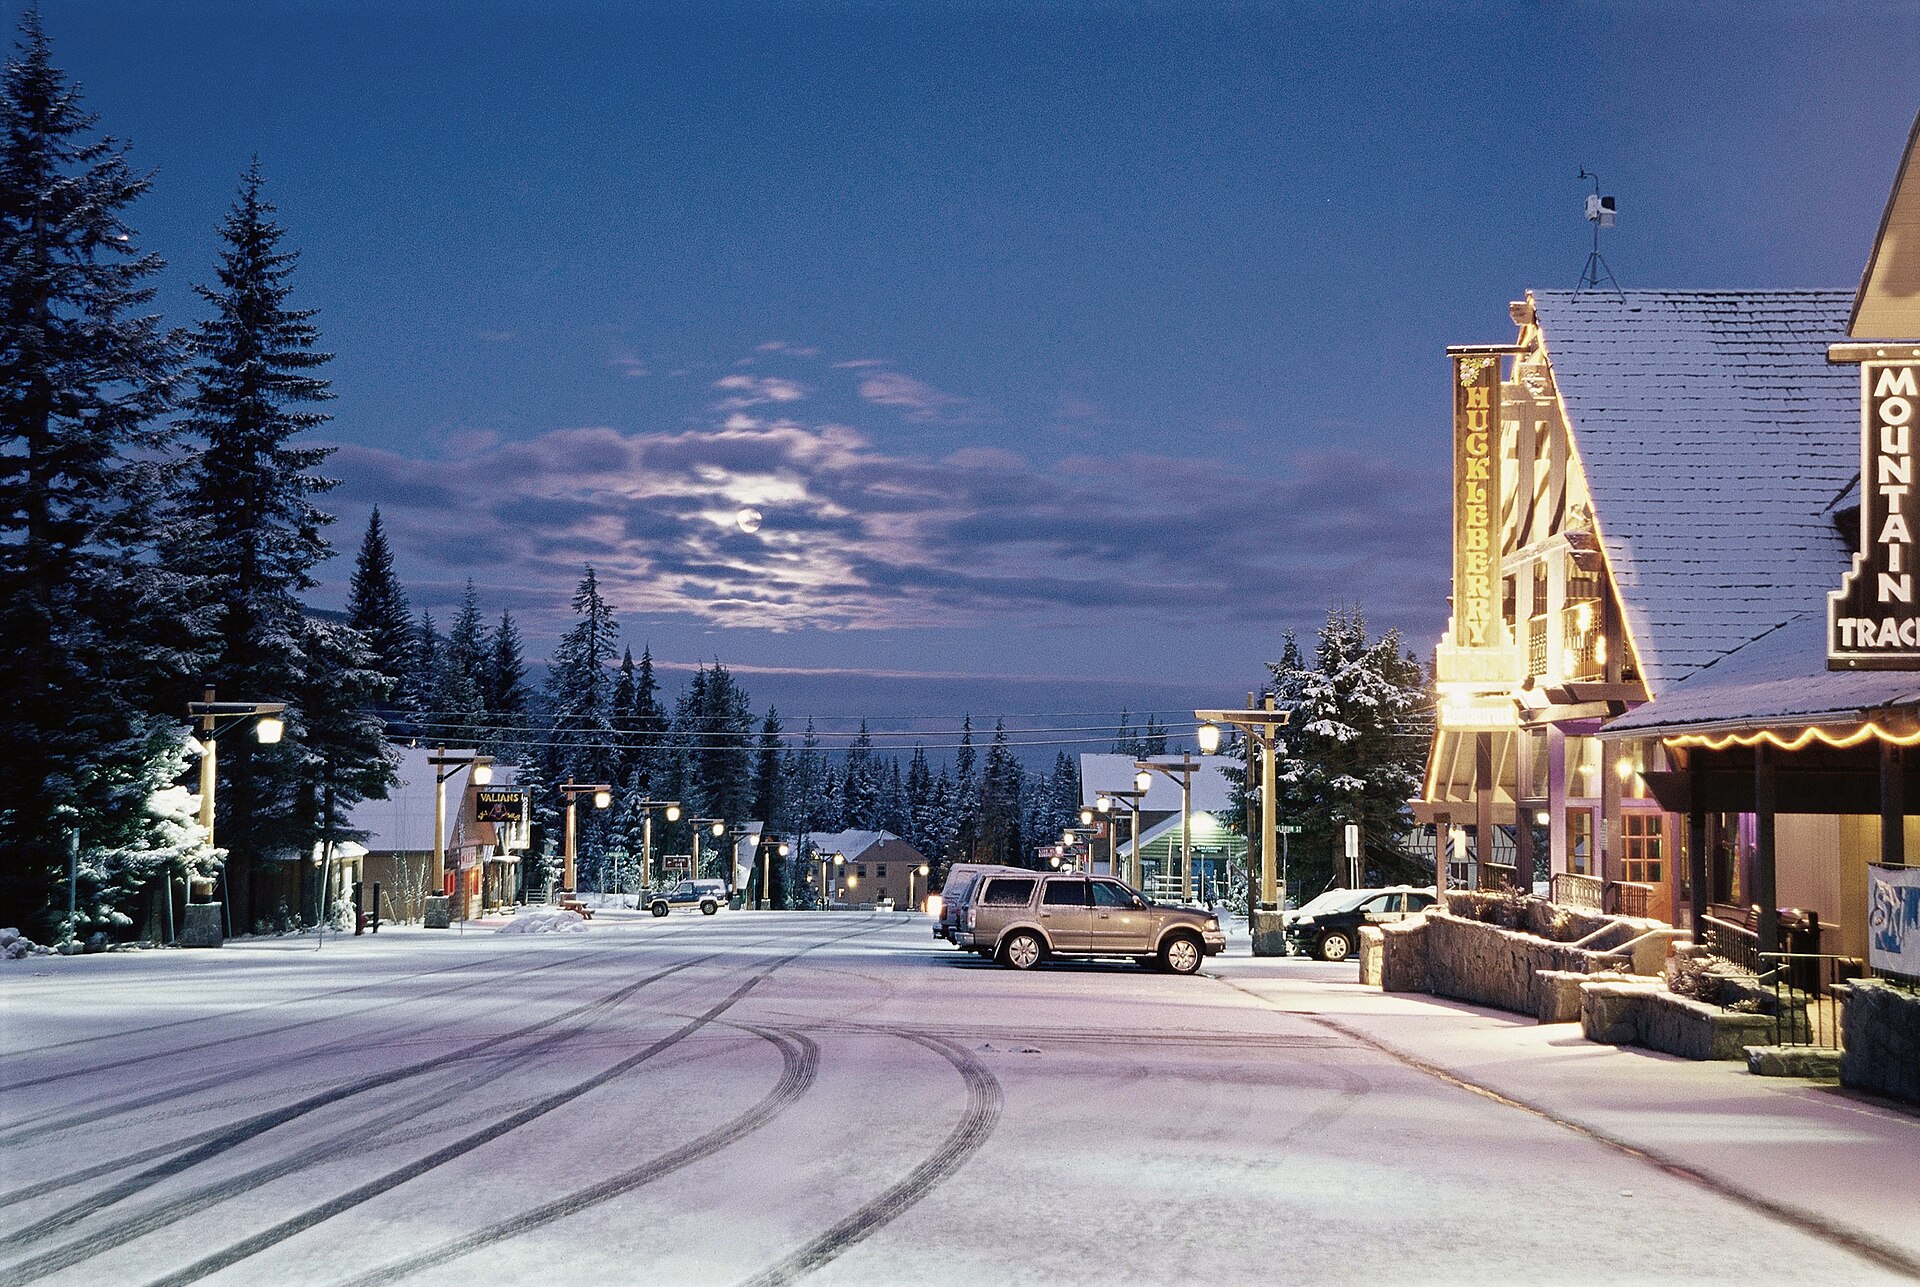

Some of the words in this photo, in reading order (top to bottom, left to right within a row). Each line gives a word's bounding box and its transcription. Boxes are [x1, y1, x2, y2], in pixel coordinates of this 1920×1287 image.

[1466, 386, 1490, 643] HUCKLEBERRY
[1874, 367, 1918, 602] MOUNTAIN
[1837, 617, 1920, 647] TRAC
[480, 793, 519, 802] VALIANS
